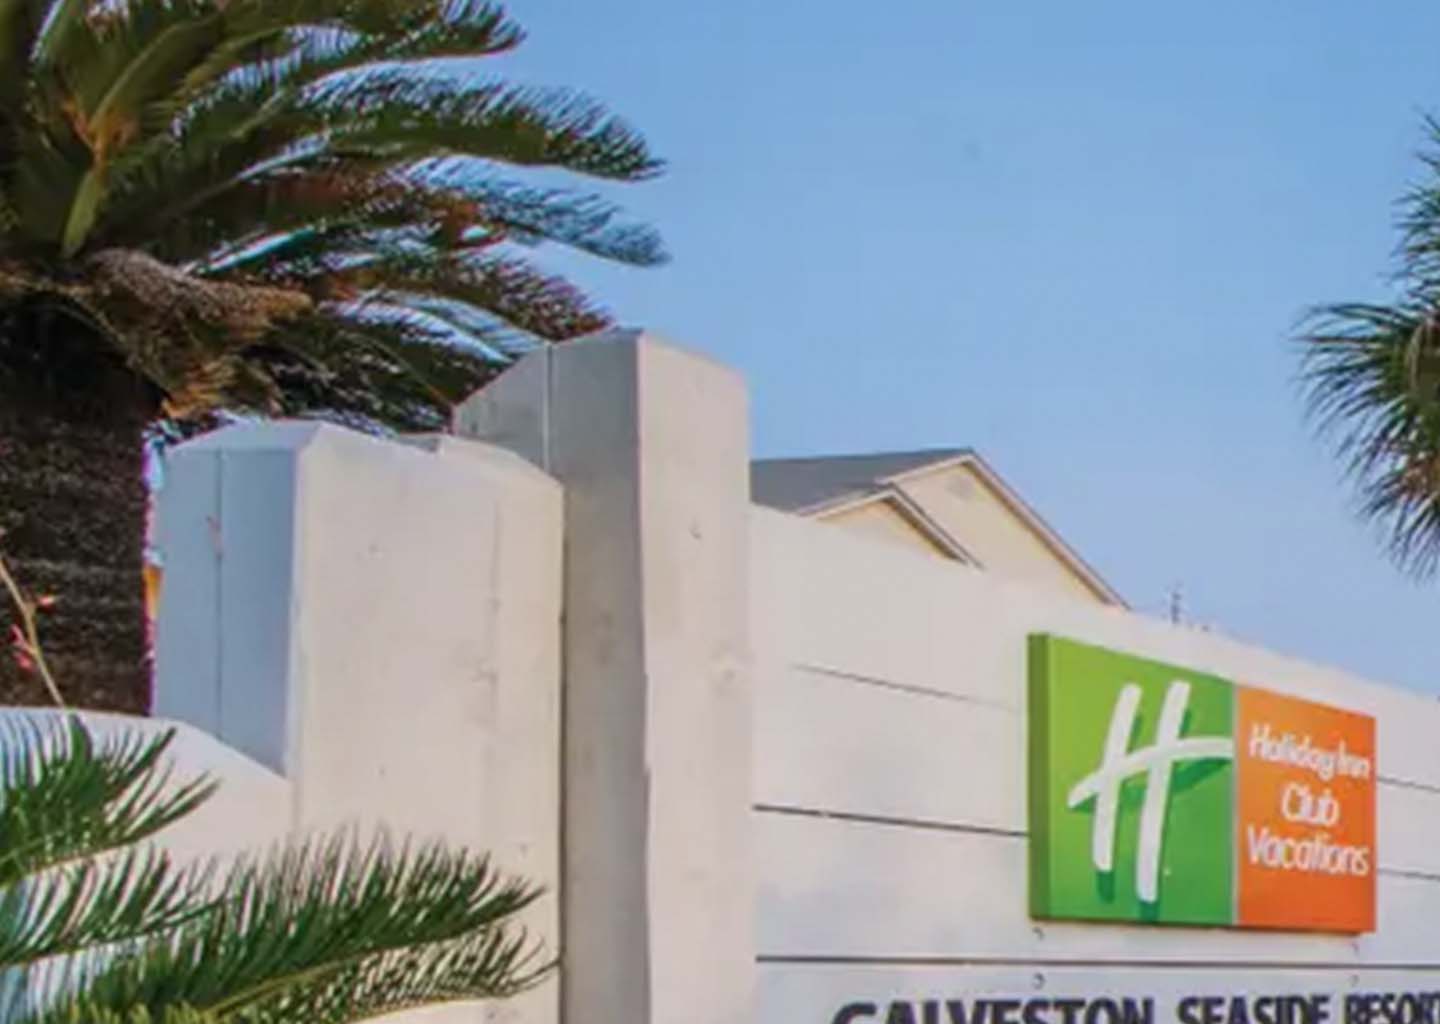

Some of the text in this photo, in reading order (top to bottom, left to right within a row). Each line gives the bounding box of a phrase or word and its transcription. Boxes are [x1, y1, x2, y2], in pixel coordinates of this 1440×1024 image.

[1248, 722, 1371, 781] Holiday Inn
[1281, 781, 1340, 828] Club
[1247, 823, 1370, 877] Vacations
